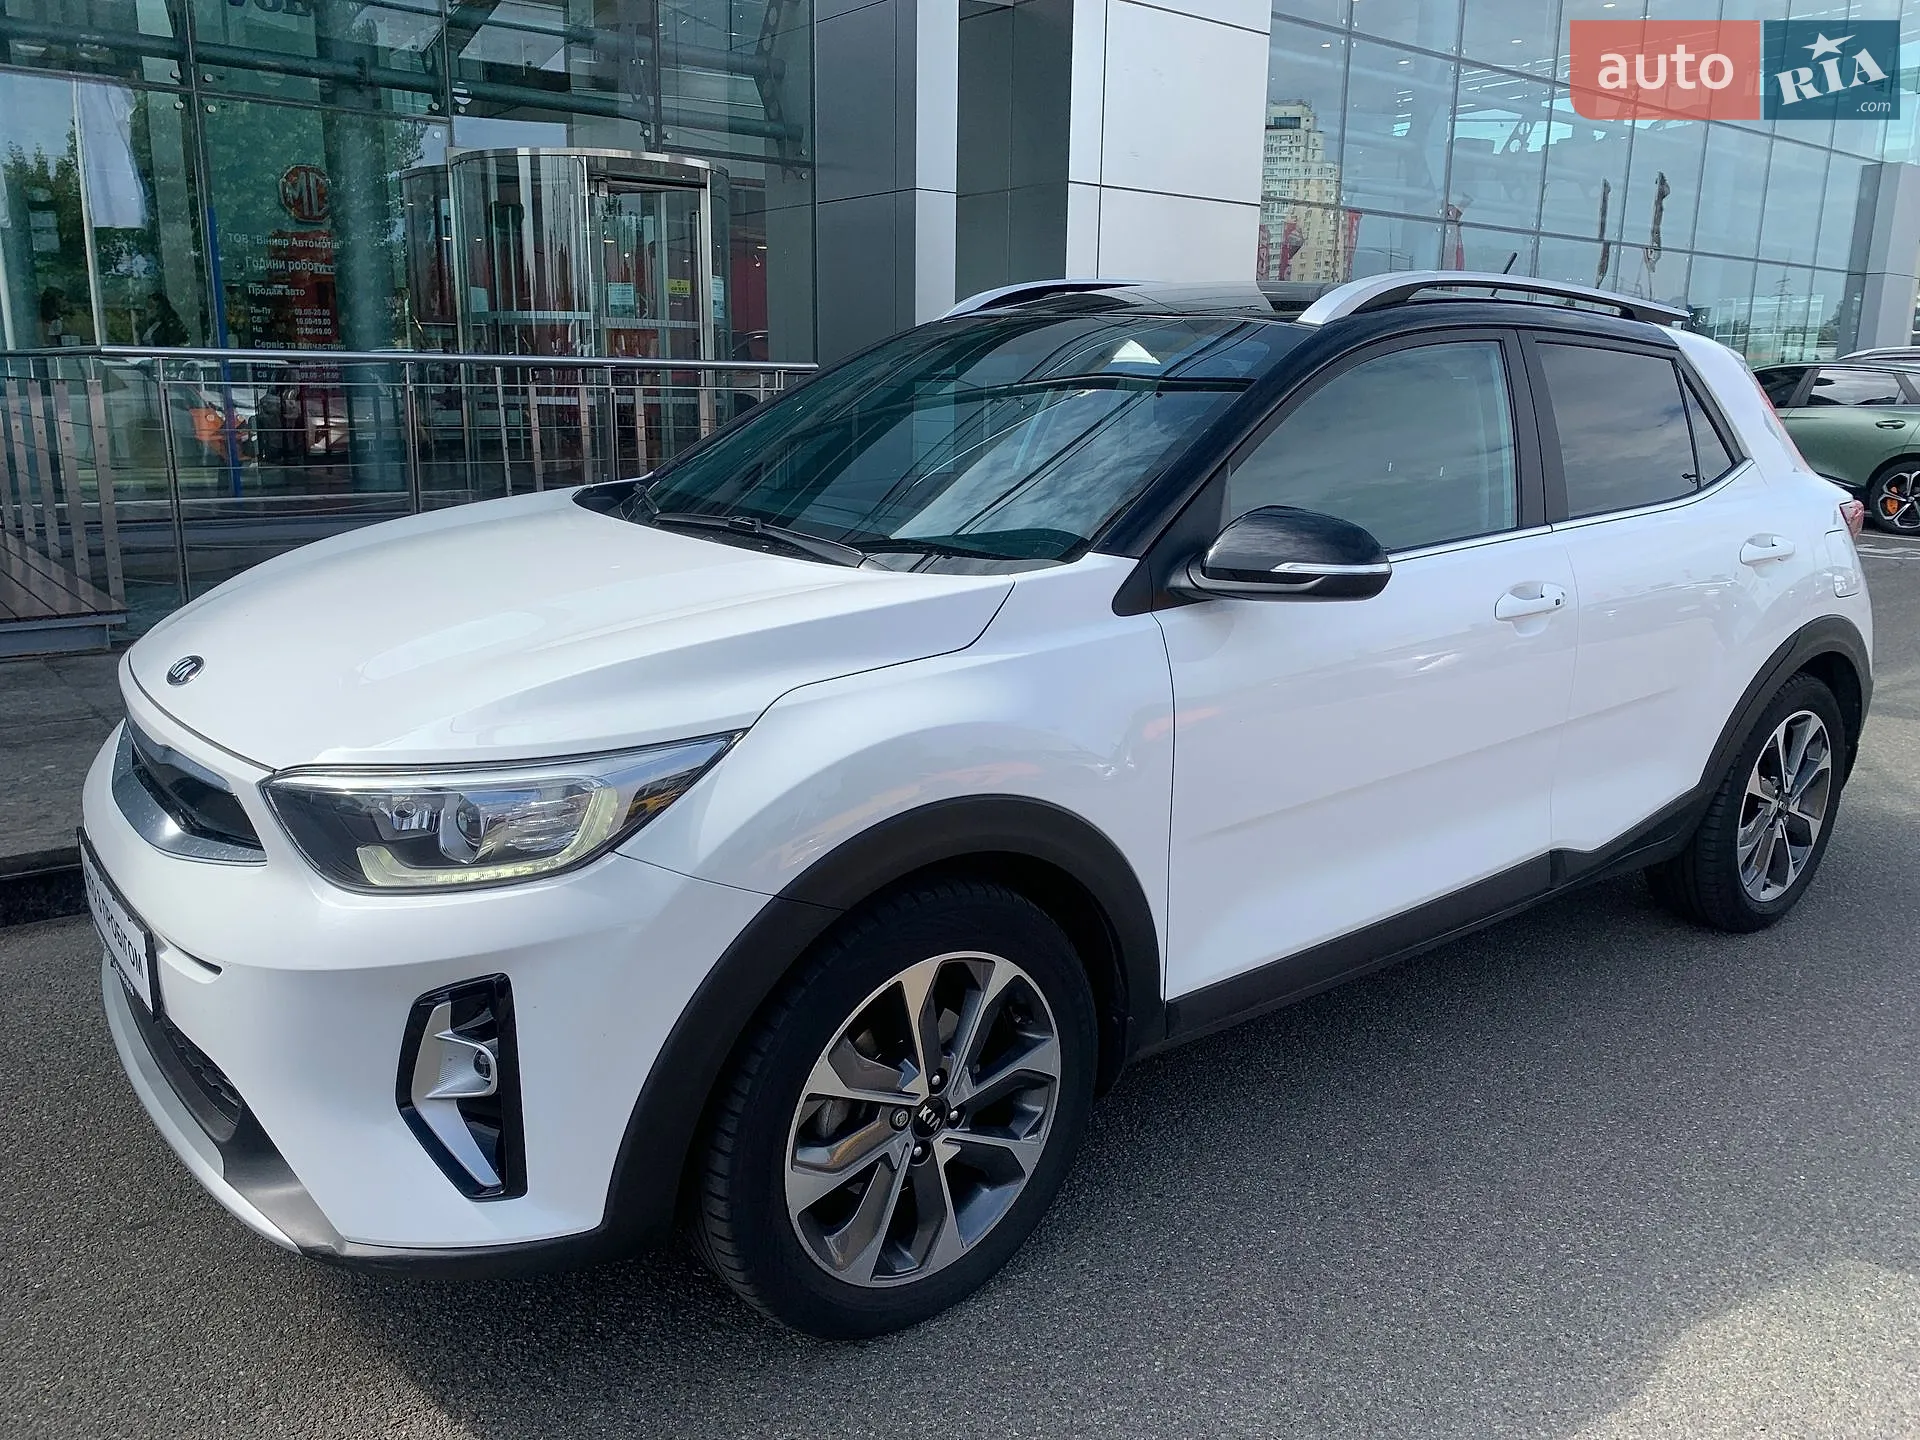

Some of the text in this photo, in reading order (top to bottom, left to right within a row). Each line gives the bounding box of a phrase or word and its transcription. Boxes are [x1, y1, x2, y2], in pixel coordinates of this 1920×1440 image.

[245, 256, 286, 271] Години
[248, 285, 306, 297] Продаж авто
[918, 1104, 941, 1131] KIA
